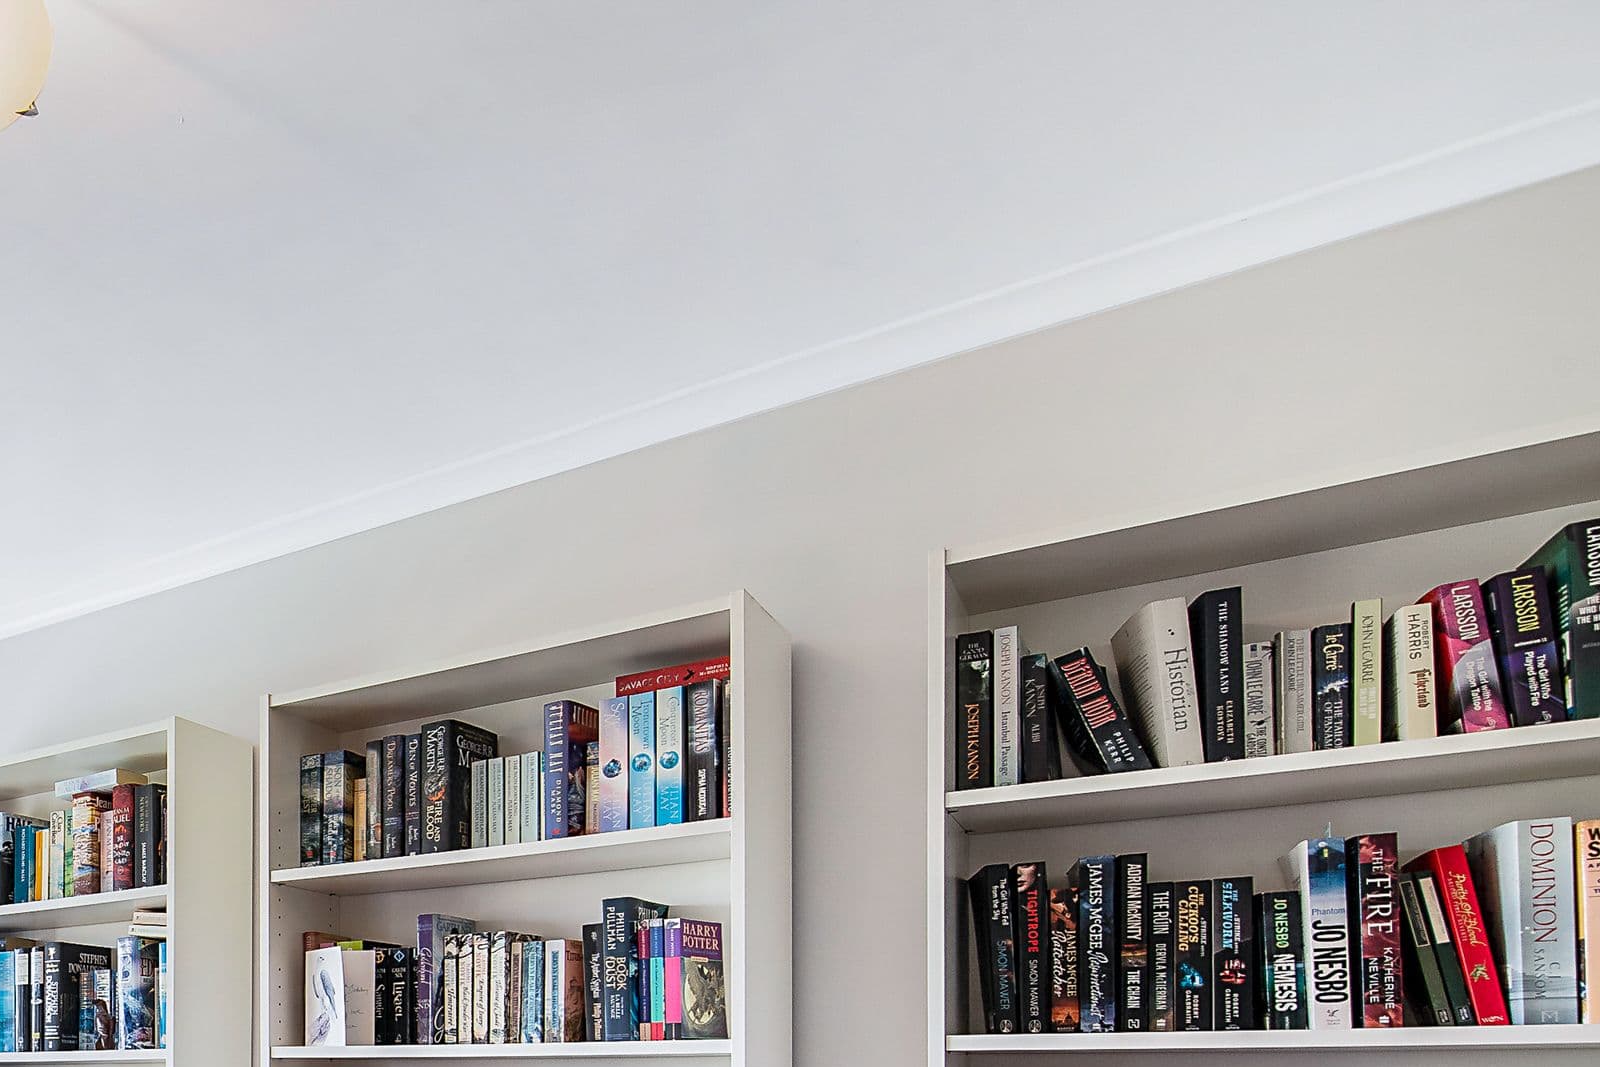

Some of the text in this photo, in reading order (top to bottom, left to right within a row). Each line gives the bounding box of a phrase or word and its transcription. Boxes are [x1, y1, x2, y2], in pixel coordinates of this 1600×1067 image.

[1452, 585, 1480, 640] LARSSON
[1512, 575, 1540, 632] LARSSON
[1219, 602, 1229, 694] THE SHADOW LAND
[1407, 614, 1421, 660] HARRIS
[1421, 620, 1430, 650] ROBERT
[1001, 634, 1011, 706] JOSEPH KANON
[1246, 660, 1264, 682] JOHN
[1465, 661, 1481, 711] Dragon Tattoo
[1525, 652, 1537, 677] Played
[1061, 658, 1117, 728] BERLIN NOIR
[1165, 648, 1191, 732] Historian
[1334, 700, 1343, 717] THE
[1409, 668, 1431, 708] Fatherland
[631, 705, 643, 736] Moon
[660, 717, 670, 747] Moon
[693, 690, 711, 754] ROMANITAS
[964, 704, 980, 779] JOSEPH KANON
[1001, 711, 1011, 742] Istanbul
[1226, 700, 1234, 743] ELIZABETH
[426, 728, 438, 771] MARTIN
[1104, 740, 1121, 763] KERR
[1113, 732, 1135, 762] PHILIP
[409, 770, 418, 808] WOLVES
[426, 804, 435, 841] BLOOD
[434, 800, 443, 824] FIRE
[1087, 863, 1104, 905] JAMES
[1127, 863, 1143, 941] ADRIAN McKINTY
[1153, 890, 1169, 911] THE
[1365, 849, 1393, 937] THE FIRE
[1530, 824, 1558, 944] DOMINION
[606, 905, 617, 951] PULLMAN
[615, 911, 626, 943] PHILIP
[682, 922, 719, 935] HARRY
[1027, 889, 1039, 953] TIGHTROPE
[1177, 900, 1189, 953] CALLING
[1188, 886, 1200, 944] CUCKOO'S
[1222, 881, 1234, 950] SILKWORM
[1312, 919, 1346, 943] JO
[1461, 917, 1486, 948] Blood
[682, 934, 721, 952] POTTER
[1050, 929, 1070, 998] Ratcatcher
[1066, 929, 1077, 962] JAMES
[1154, 942, 1169, 970] DERVLA
[616, 956, 627, 992] BOOK
[996, 939, 1012, 1011] SIMON MAWER
[1029, 958, 1041, 1017] SIMON MAWER
[1085, 950, 1109, 1018] Resurrectionist
[1127, 969, 1141, 1009] THE CHAIN
[1273, 953, 1298, 1012] NEMESIS
[1367, 956, 1381, 1004] NEVILLE
[1383, 946, 1396, 1010] KATHERINE
[1533, 949, 1547, 1000] SANSOM
[44, 975, 53, 1023] DONALDSON
[51, 981, 59, 1016] STEPHEN
[1184, 989, 1192, 1025] GALBRAITH
[1224, 988, 1232, 1024] GALBRAITH
